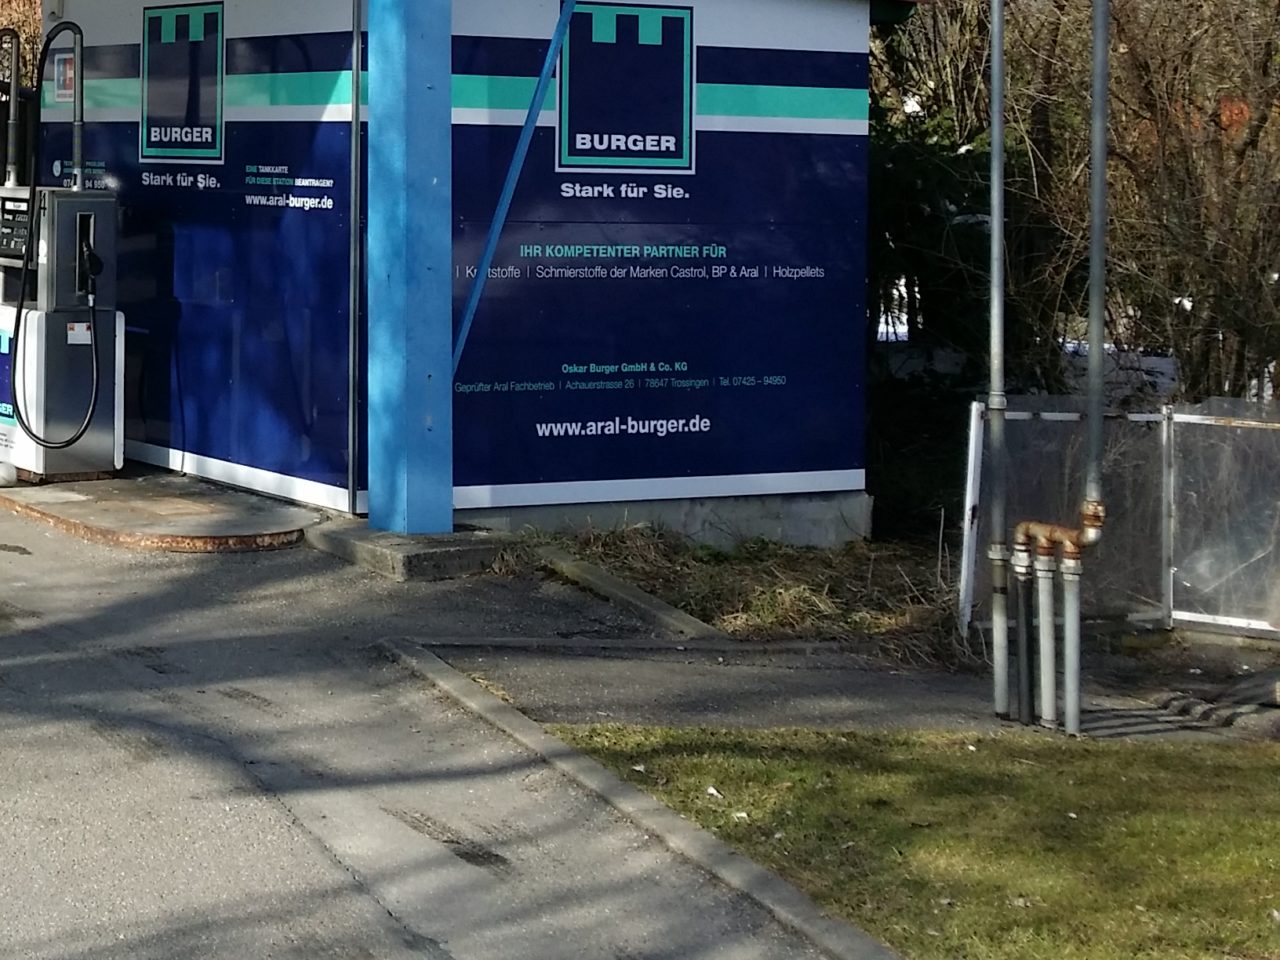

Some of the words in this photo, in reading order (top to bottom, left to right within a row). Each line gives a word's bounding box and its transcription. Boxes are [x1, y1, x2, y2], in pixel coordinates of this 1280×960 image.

[150, 126, 213, 143] BURGER
[575, 133, 676, 151] BURGER
[141, 172, 174, 186] Stark
[176, 172, 194, 187] für
[197, 173, 221, 189] Sie.
[560, 182, 615, 198] Stark
[619, 183, 648, 198] für
[653, 184, 690, 199] Sie.
[245, 194, 333, 210] www.aral-burger.de
[520, 245, 542, 258] IHR
[545, 245, 641, 258] KOMPETENTER
[643, 245, 700, 258] PARTNER
[702, 243, 727, 258] FÜR
[465, 265, 521, 279] Krtstoffe
[535, 265, 606, 279] Schmierstoffe
[609, 265, 627, 279] der
[629, 265, 668, 278] Marken
[670, 265, 709, 280] Castrol,
[711, 265, 727, 278] BP
[729, 265, 738, 278] &
[739, 265, 759, 278] Aral
[773, 265, 825, 280] Holzpellets
[561, 363, 587, 374] Oskar
[589, 363, 619, 375] Burger
[621, 362, 647, 372] GmbH
[649, 362, 656, 372] &
[658, 362, 672, 372] Co.
[674, 361, 688, 371] KG
[454, 381, 491, 394] Geprüfter
[493, 381, 508, 392] Aral
[510, 380, 555, 391] Fachbetrieb
[565, 379, 623, 390] Achauerstrasse
[624, 378, 635, 389] 26
[644, 378, 669, 388] 78647
[671, 377, 710, 390] Trossingen
[732, 376, 756, 386] 07425
[536, 415, 711, 436] www.aral-burger.de
